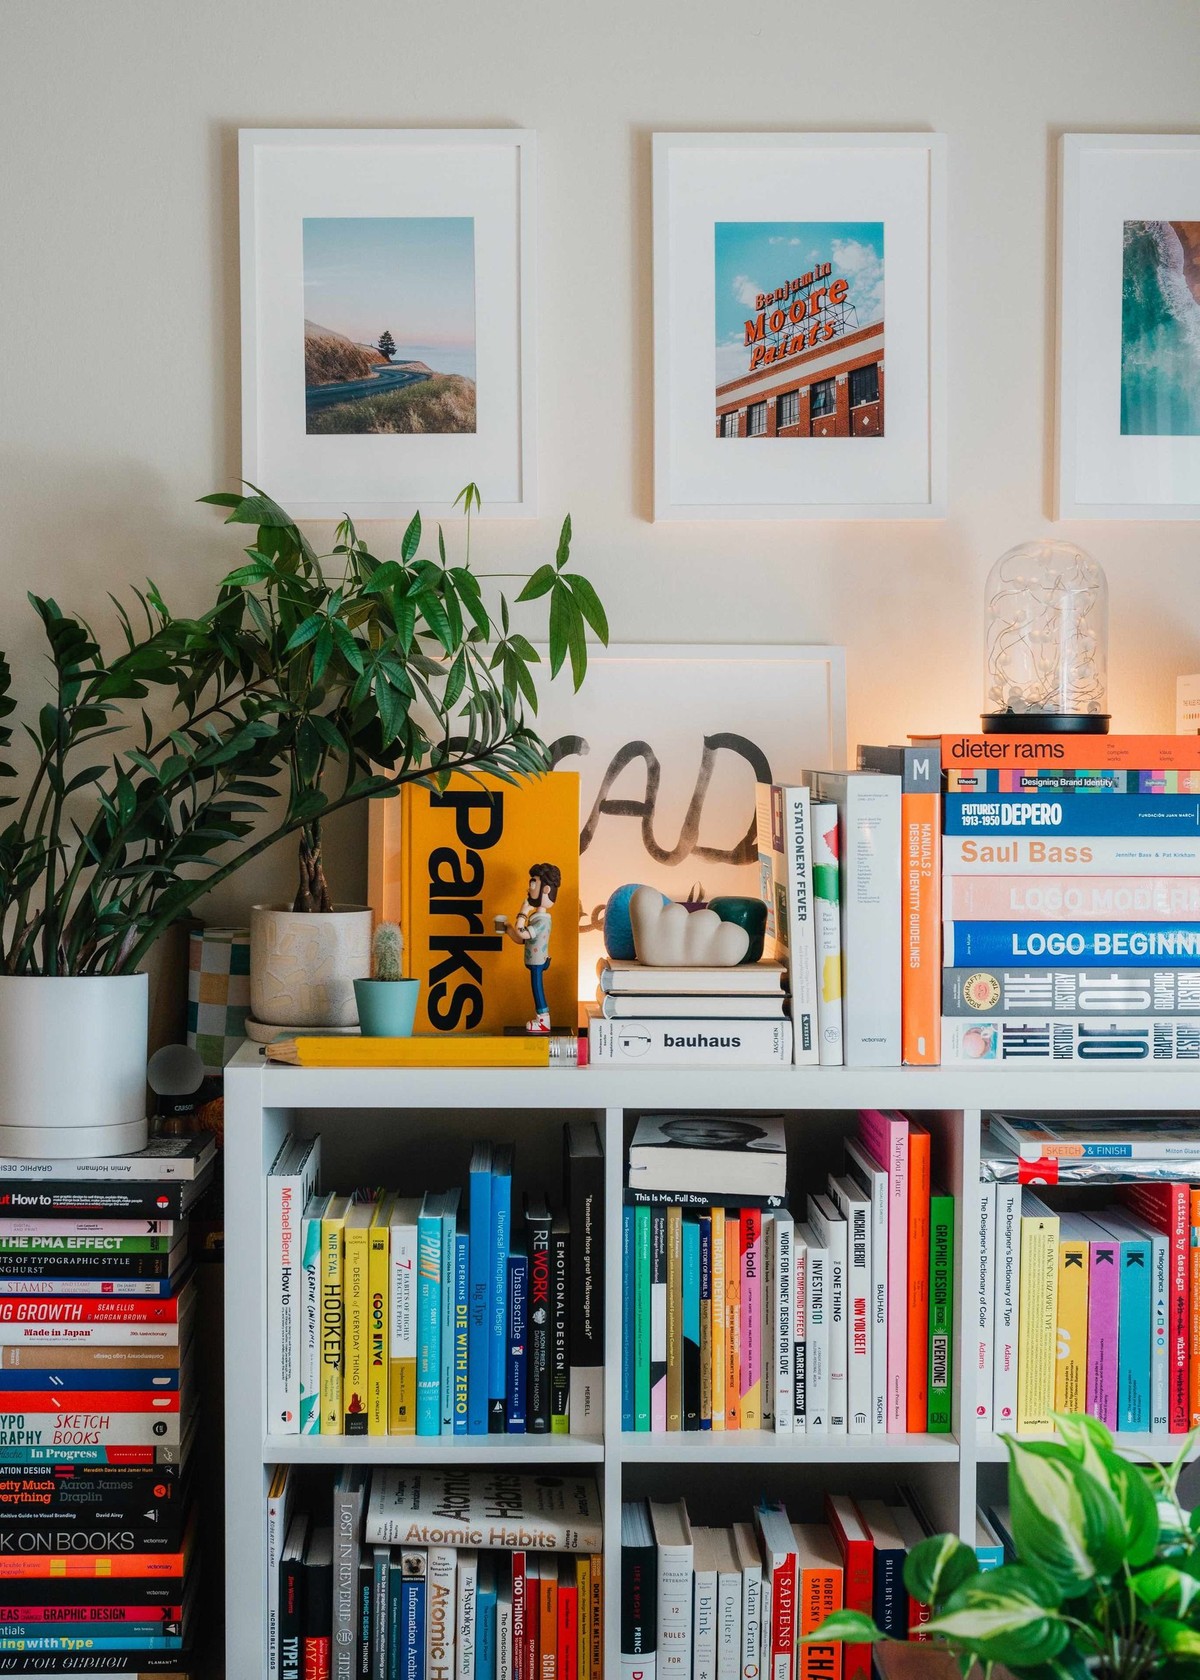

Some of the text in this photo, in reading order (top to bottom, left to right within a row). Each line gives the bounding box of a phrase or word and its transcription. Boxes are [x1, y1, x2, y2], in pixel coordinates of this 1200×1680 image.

[755, 262, 832, 311] Benjamin
[744, 278, 849, 347] Moore
[749, 320, 836, 372] Paints
[952, 738, 1065, 759] dieter rams
[1021, 776, 1114, 790] Designing Brand Identity
[961, 803, 1000, 816] FUTURIST
[961, 815, 1000, 827] 1913-1950
[1001, 803, 1063, 826] DEPERO
[794, 801, 807, 922] STATIONERY FEVER
[960, 840, 1094, 863] Saul Bass
[428, 790, 504, 1032] Parks
[1004, 972, 1053, 1011] THE
[1054, 972, 1076, 1011] HISTORY
[1078, 972, 1152, 1011] OF
[1154, 972, 1175, 1011] GRAPHIC
[663, 1033, 741, 1048] bauhaus
[803, 1022, 811, 1049] PRESTEL
[1002, 1023, 1050, 1061] THE
[1053, 1023, 1074, 1061] HISTORY
[1077, 1023, 1149, 1061] OF
[1153, 1023, 1173, 1061] GRAPHIC
[76, 1164, 132, 1173] Armin Hofmann
[891, 1137, 905, 1198] Marylou Faure
[1046, 1146, 1127, 1155] SKETCH & FINISH
[281, 1186, 293, 1229] Michael
[634, 1193, 709, 1205] This Is Me, Full Stop.
[0, 1237, 124, 1249] THE PMA EFFECT
[281, 1230, 293, 1265] Bierut
[327, 1232, 338, 1250] NIR
[419, 1228, 441, 1283] SPRINT
[584, 1235, 592, 1254] those
[745, 1218, 757, 1278] extra bold
[934, 1224, 948, 1267] GRAPHIC
[281, 1265, 293, 1290] How
[327, 1252, 338, 1277] EYAL
[532, 1229, 549, 1304] REWORK
[582, 1255, 592, 1274] great
[714, 1238, 724, 1324] BRAND IDENTITY
[853, 1209, 866, 1355] MICHAEL BIERUT NOW YOU SEE IT
[1176, 1192, 1187, 1367] editing by design white
[7, 1281, 54, 1293] STAMPS
[281, 1290, 293, 1304] to
[473, 1281, 487, 1326] Big Type
[513, 1266, 525, 1341] Unsubscribe
[556, 1241, 566, 1371] EMOTIONAL DESIGN
[583, 1275, 593, 1318] Volkswagen
[778, 1231, 790, 1376] WORK FOR MONEY, DESIGN FOR LOVE
[833, 1266, 842, 1322] ONE THING
[934, 1269, 947, 1305] DESIGN
[97, 1303, 135, 1312] SEAN ELLIS
[323, 1283, 342, 1364] HOOKED
[352, 1251, 360, 1384] The DESIGN of EVERYDAY THINGS
[456, 1243, 468, 1412] BILL PERKINS DIE WITH ZERO
[876, 1283, 885, 1424] BAUHAUS TASCHEN
[933, 1338, 946, 1384] EVERYONE
[53, 1413, 111, 1430] SKETCH
[53, 1431, 102, 1446] BOOKS
[31, 1448, 98, 1461] In Progress
[60, 1480, 134, 1490] Aaron James
[60, 1491, 103, 1502] Draplin
[110, 1512, 124, 1520] Airey
[18, 1532, 52, 1551] ON
[56, 1532, 135, 1551] BOOKS
[405, 1523, 483, 1545] Atomic
[489, 1528, 557, 1549] Habits
[340, 1503, 353, 1621] LOST IN REVERIE
[513, 1575, 524, 1636] 100 THINGS
[778, 1578, 793, 1648] SAPIENS
[810, 1577, 821, 1623] SAPOLSKY
[824, 1577, 834, 1611] ROBERT
[884, 1559, 894, 1630] BILL BRYSON
[43, 1608, 87, 1621] GRAPHIC
[90, 1608, 126, 1620] DESIGN
[698, 1597, 713, 1636] blink
[724, 1595, 736, 1644] Outliers
[746, 1578, 760, 1659] Adam Grant
[593, 1628, 600, 1641] ME
